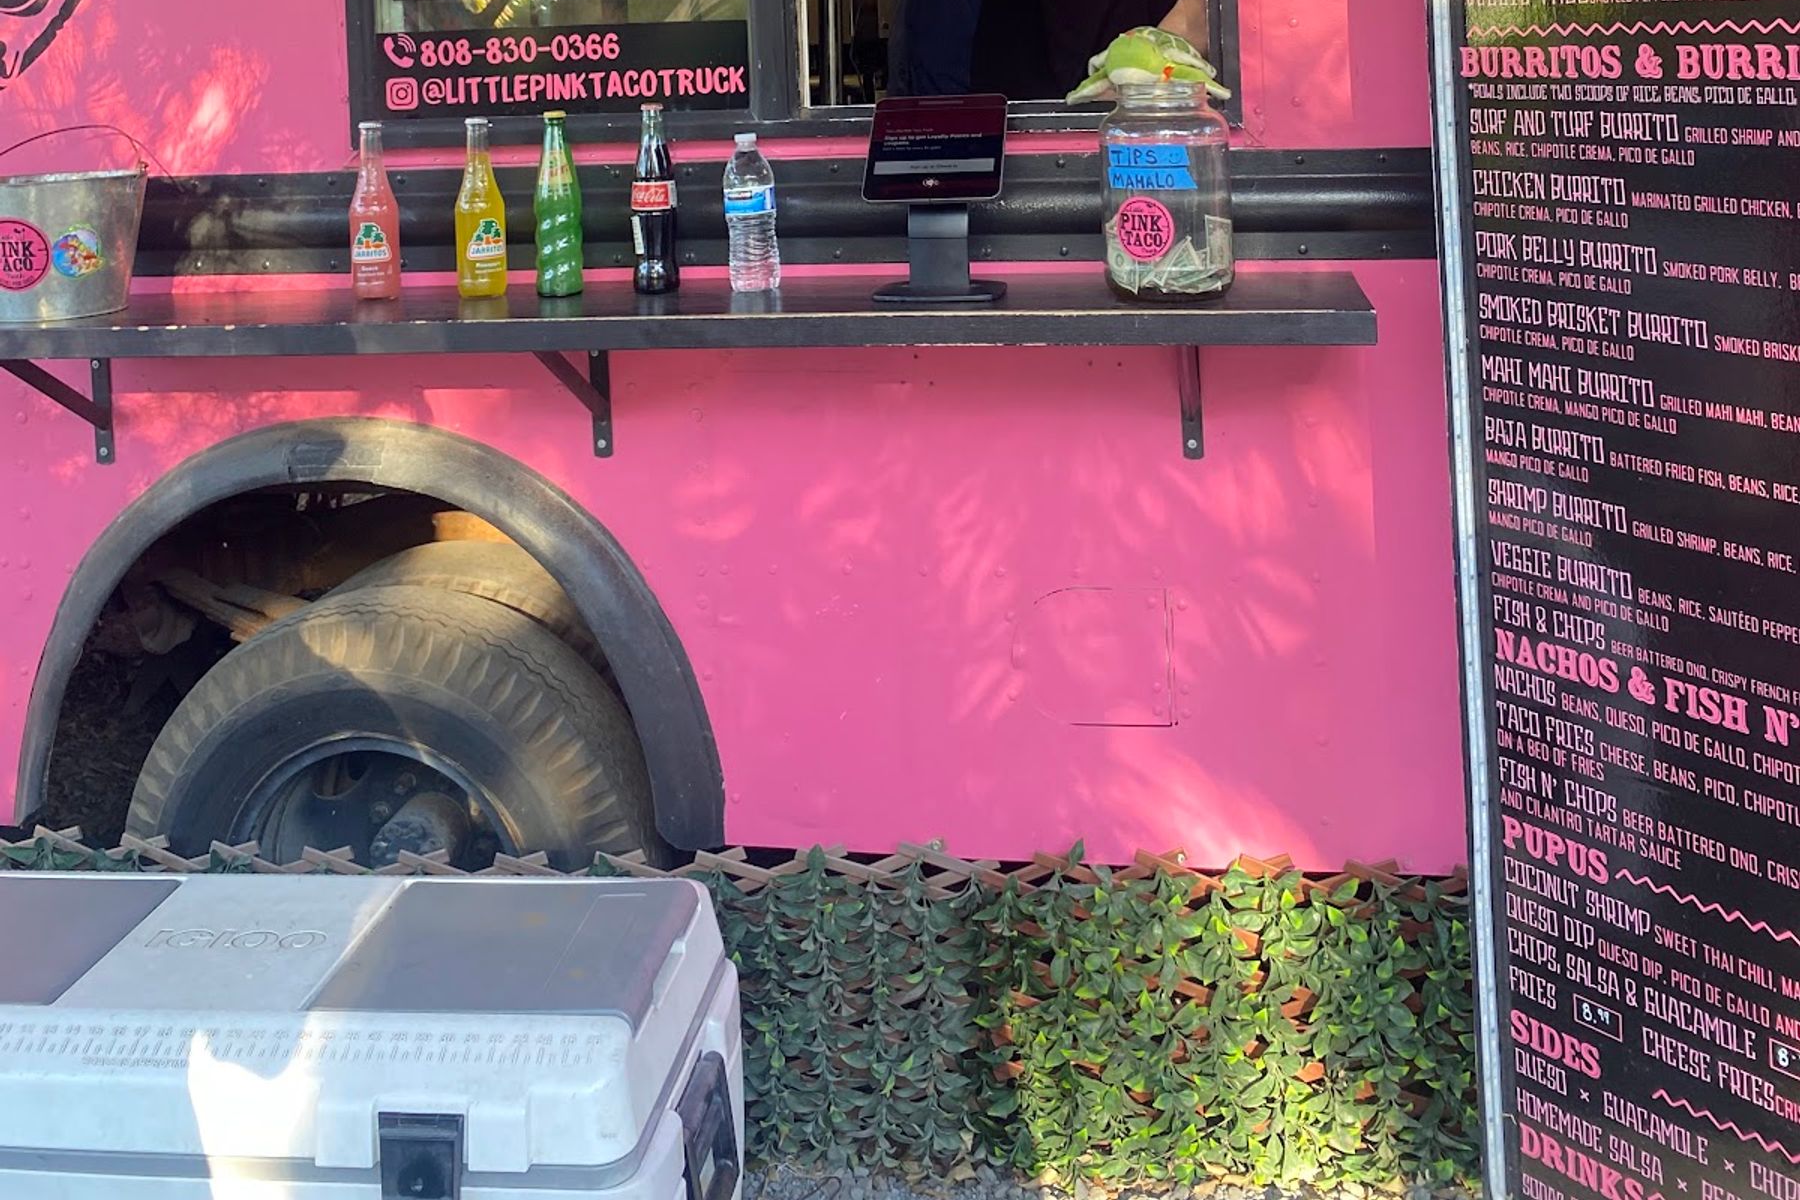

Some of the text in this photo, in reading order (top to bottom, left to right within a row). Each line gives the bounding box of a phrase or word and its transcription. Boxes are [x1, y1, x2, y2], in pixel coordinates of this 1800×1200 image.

[420, 33, 620, 67] 808-830-0366
[1460, 44, 1622, 80] BURRITOS
[1634, 43, 1664, 79] &
[422, 66, 746, 105] @LITTLEPINKTACOTRUCK
[1469, 108, 1773, 147] SURF AND TURF BURRITO GRILLED SHRIMP
[1113, 171, 1175, 188] MAHALO
[1472, 168, 1546, 201] CHICKEN
[1550, 173, 1626, 206] BURRITO
[1631, 191, 1691, 211] MARINATED
[1694, 195, 1738, 215] GRILLED
[0, 241, 36, 257] INK
[1120, 213, 1163, 232] PINK
[1125, 231, 1162, 247] TACO
[0, 258, 33, 272] ACO
[1475, 231, 1518, 260] PORK
[1522, 234, 1575, 266] BELLY
[1580, 239, 1657, 275] BURRITO
[1663, 261, 1706, 281] SMOKED
[1710, 264, 1740, 284] PORK
[1479, 292, 1760, 358] SMOKED BRISKET BURRITO SMOKED
[1481, 354, 1524, 386] MAHI
[1528, 361, 1572, 395] MAHI
[1578, 368, 1655, 408] BURRITO
[1660, 394, 1702, 417] GRILLED
[1705, 400, 1734, 423] MAHI
[1485, 416, 1528, 450] BAJA
[1531, 424, 1606, 465] BURRITO
[1609, 451, 1662, 477] BATTERED
[1665, 461, 1695, 483] FRIED
[1487, 478, 1628, 535] SHRIMP BURRITO
[1491, 539, 1633, 600] VEGGIE BURRITO
[1493, 594, 1606, 651] FISH & CHIPS
[1494, 627, 1621, 693] NACHOS
[1627, 665, 1656, 706] &
[1663, 676, 1750, 735] FISH
[1494, 664, 1556, 707] NACHOS
[1652, 721, 1681, 747] PICO
[1684, 730, 1700, 754] DE
[1496, 700, 1541, 740] TACO
[1545, 716, 1595, 757] FRIES
[1499, 755, 1537, 794] FISH
[1564, 779, 1617, 823] CHIPS
[1501, 814, 1609, 886] PUPUS
[142, 927, 328, 951] IGLOO
[1503, 856, 1580, 909] COCONUT
[1586, 889, 1650, 937] SHRIMP
[1654, 924, 1698, 959] SWEET
[1702, 944, 1734, 974] THAI
[1506, 891, 1595, 950] QUESO DIP
[1509, 965, 1557, 1011] FRIES
[1566, 953, 1620, 1001] SALSA
[1625, 977, 1638, 1008] &
[1644, 986, 1757, 1061] GUACAMOLE
[1582, 1002, 1611, 1025] 8.99
[1510, 1008, 1601, 1080] SIDES
[1642, 1026, 1775, 1113] CHEESE FRIES
[1514, 1047, 1709, 1166] QUESO GUACAMOLE
[1516, 1086, 1664, 1185] HOMEMADE SALSA
[1520, 1122, 1644, 1200] DRINKS
